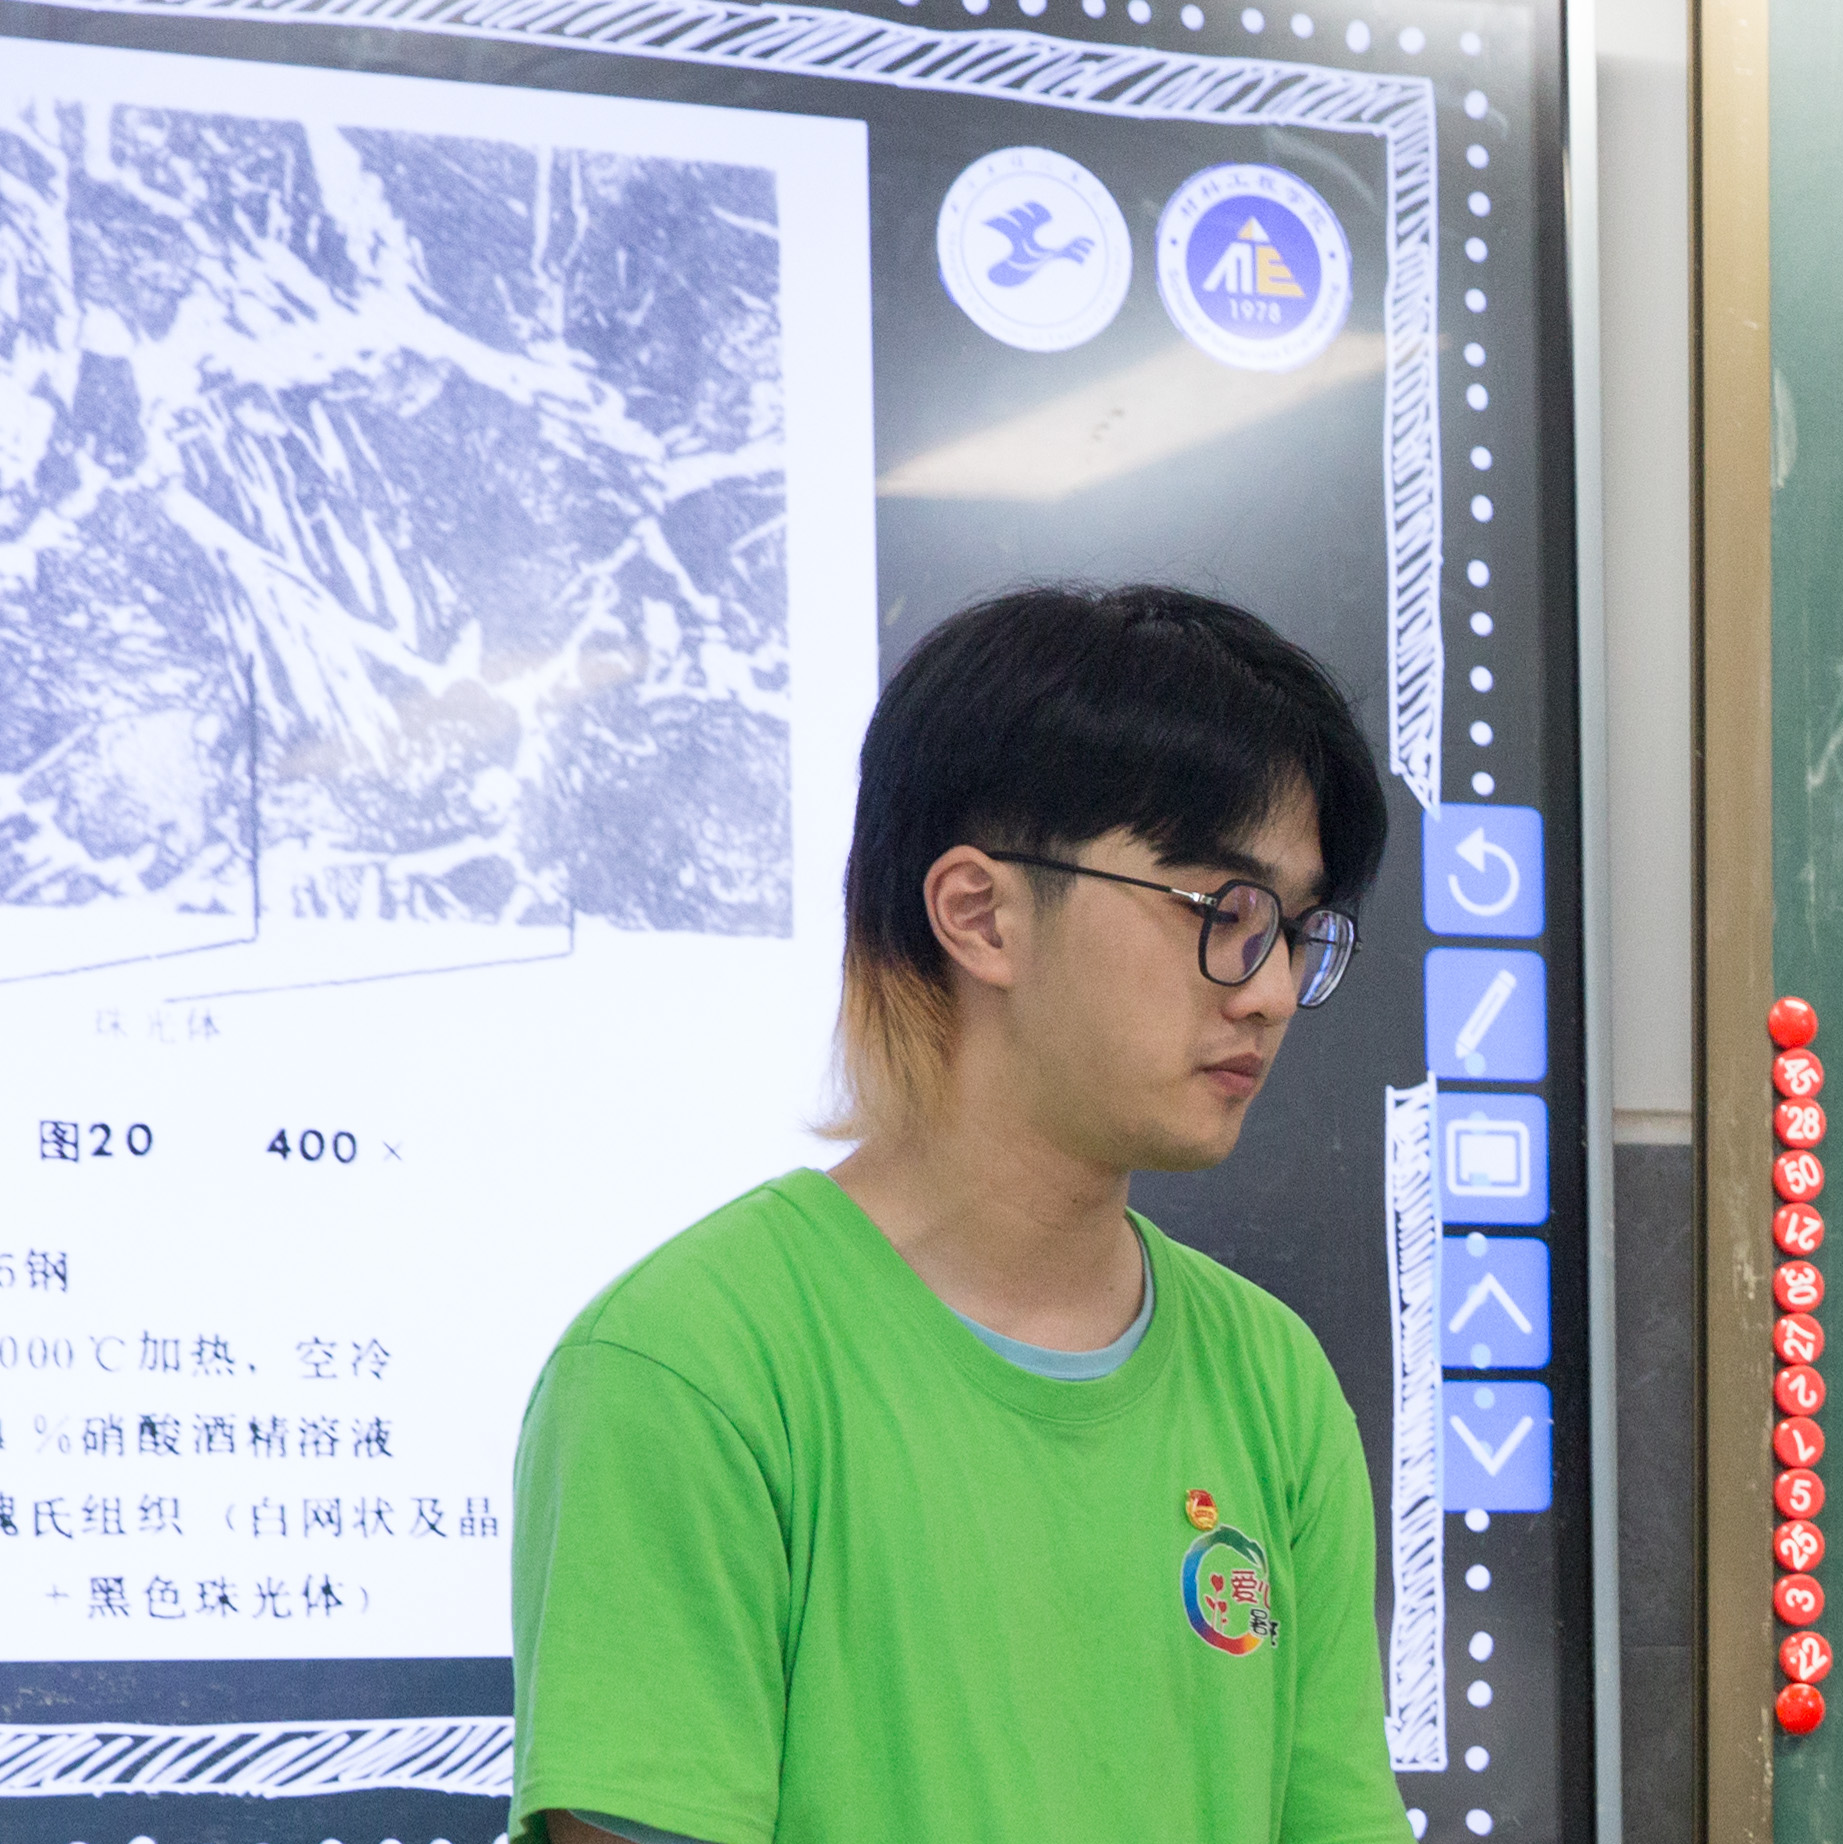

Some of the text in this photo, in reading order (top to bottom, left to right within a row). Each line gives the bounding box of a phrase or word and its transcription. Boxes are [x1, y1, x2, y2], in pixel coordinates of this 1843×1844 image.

[1229, 299, 1282, 325] 1978
[1784, 1058, 1819, 1094] 45
[39, 1119, 154, 1164] 图20
[1786, 1106, 1820, 1139] 28
[265, 1127, 358, 1165] 400
[1785, 1154, 1820, 1194] 50
[1785, 1212, 1821, 1251] 21
[1784, 1267, 1818, 1305] 30
[1783, 1319, 1815, 1361] 27
[1788, 1374, 1817, 1408] 2
[0, 1412, 395, 1459] %硝酸酒精溶液
[1790, 1479, 1811, 1511] 5
[1780, 1524, 1818, 1570] 25
[1785, 1588, 1815, 1612] 3
[1798, 1637, 1828, 1680] 22
